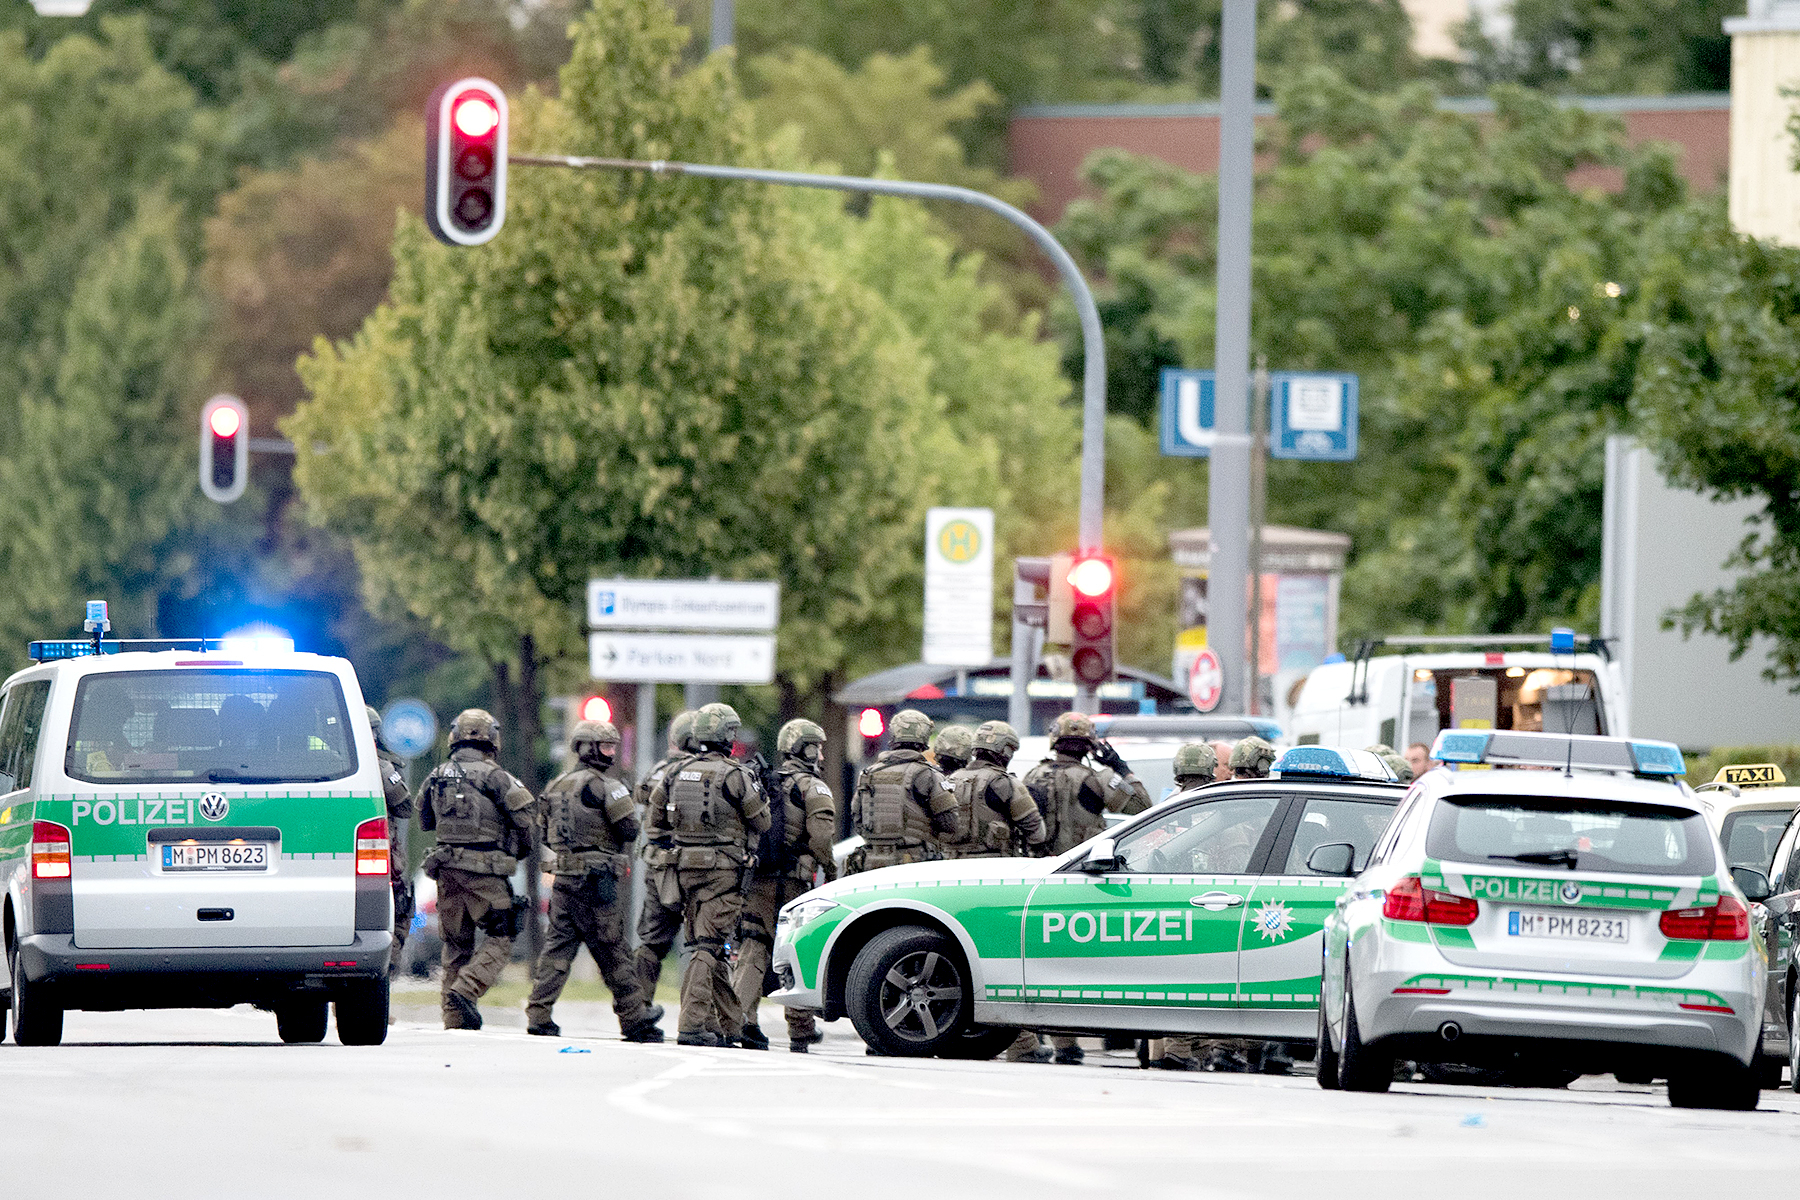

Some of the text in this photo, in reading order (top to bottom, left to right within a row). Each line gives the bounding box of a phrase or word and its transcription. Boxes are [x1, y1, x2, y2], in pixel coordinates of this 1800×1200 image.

[1728, 769, 1772, 782] TAXI
[72, 800, 194, 826] POLIZEI
[173, 847, 264, 864] M PM 8623
[1471, 877, 1559, 900] POLIZEI
[1042, 910, 1193, 943] POLIZEI
[1521, 915, 1625, 939] M PM 8231
